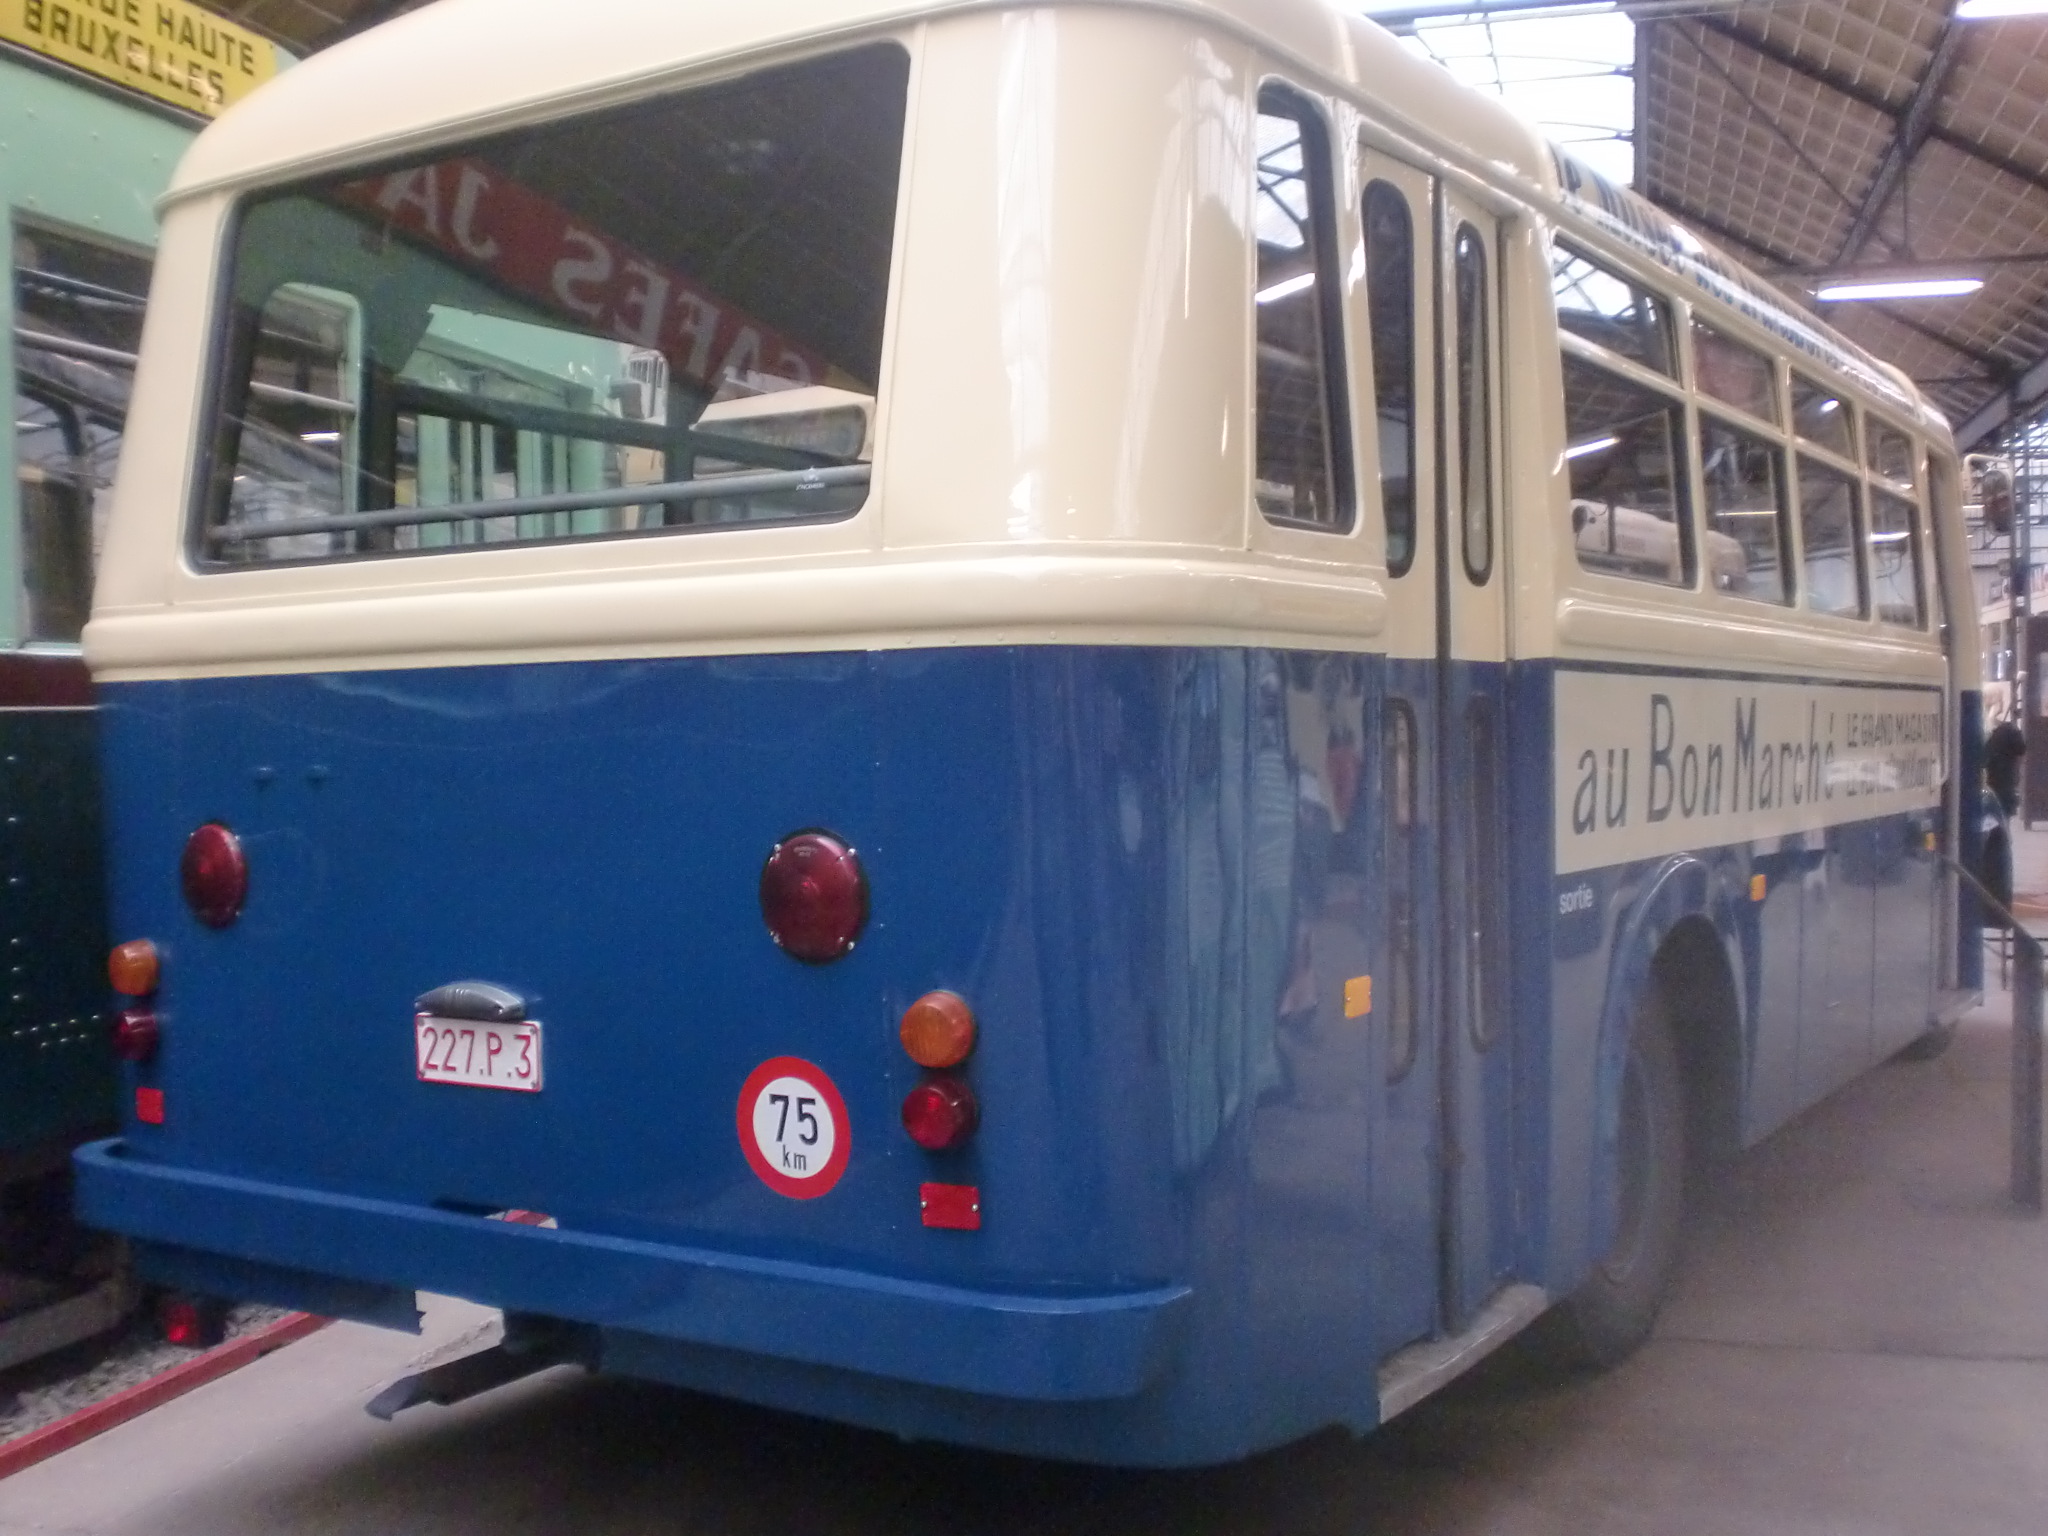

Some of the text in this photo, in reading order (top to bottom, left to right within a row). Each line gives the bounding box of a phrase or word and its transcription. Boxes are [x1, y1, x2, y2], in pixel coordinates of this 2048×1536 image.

[23, 0, 224, 104] BRUXELLES
[155, 3, 254, 76] HAUTE
[1572, 749, 1629, 835] au
[1646, 693, 1723, 823] Bon
[1732, 697, 1834, 813] Marché
[1560, 883, 1593, 915] sortie
[769, 1093, 819, 1146] 75
[782, 1144, 807, 1171] km
